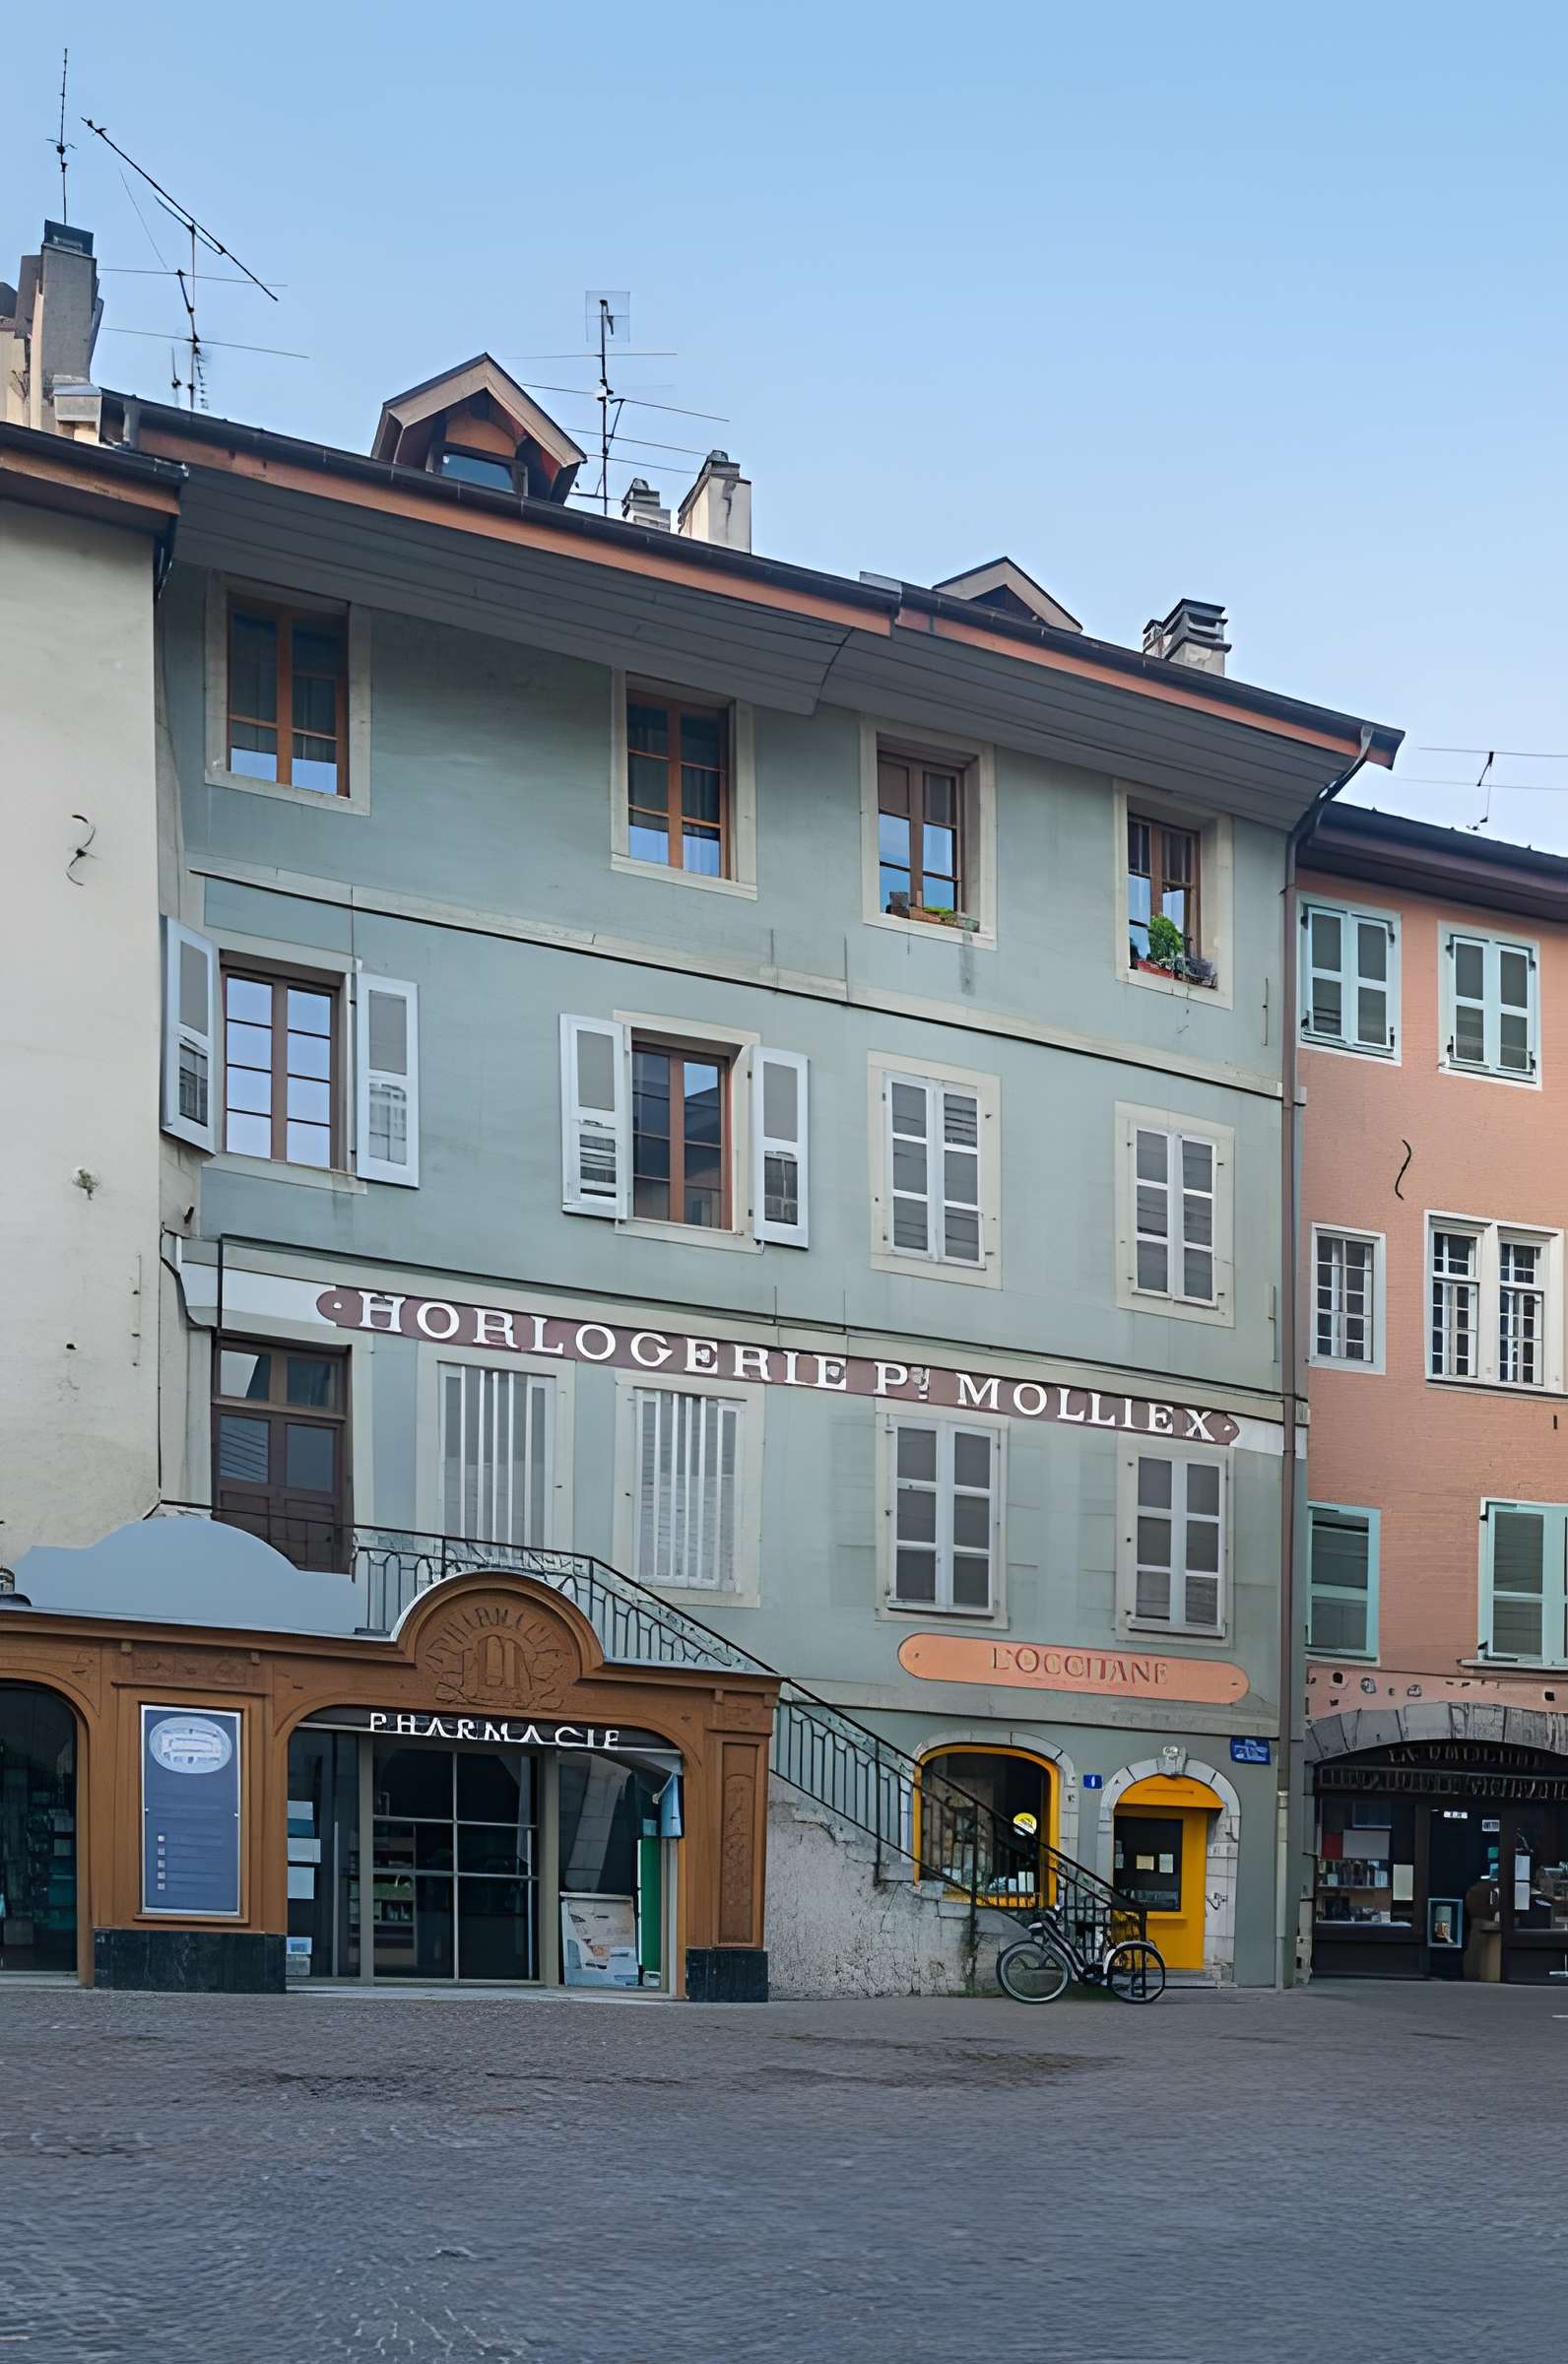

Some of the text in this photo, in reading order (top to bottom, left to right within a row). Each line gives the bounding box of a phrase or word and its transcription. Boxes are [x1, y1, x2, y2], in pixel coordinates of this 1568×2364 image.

[358, 1290, 847, 1391] HORLOGERIE
[955, 1372, 1216, 1443] MOLLIEX
[993, 1647, 1168, 1684] L'OCCITANE
[370, 1712, 620, 1750] PHARMACIE
